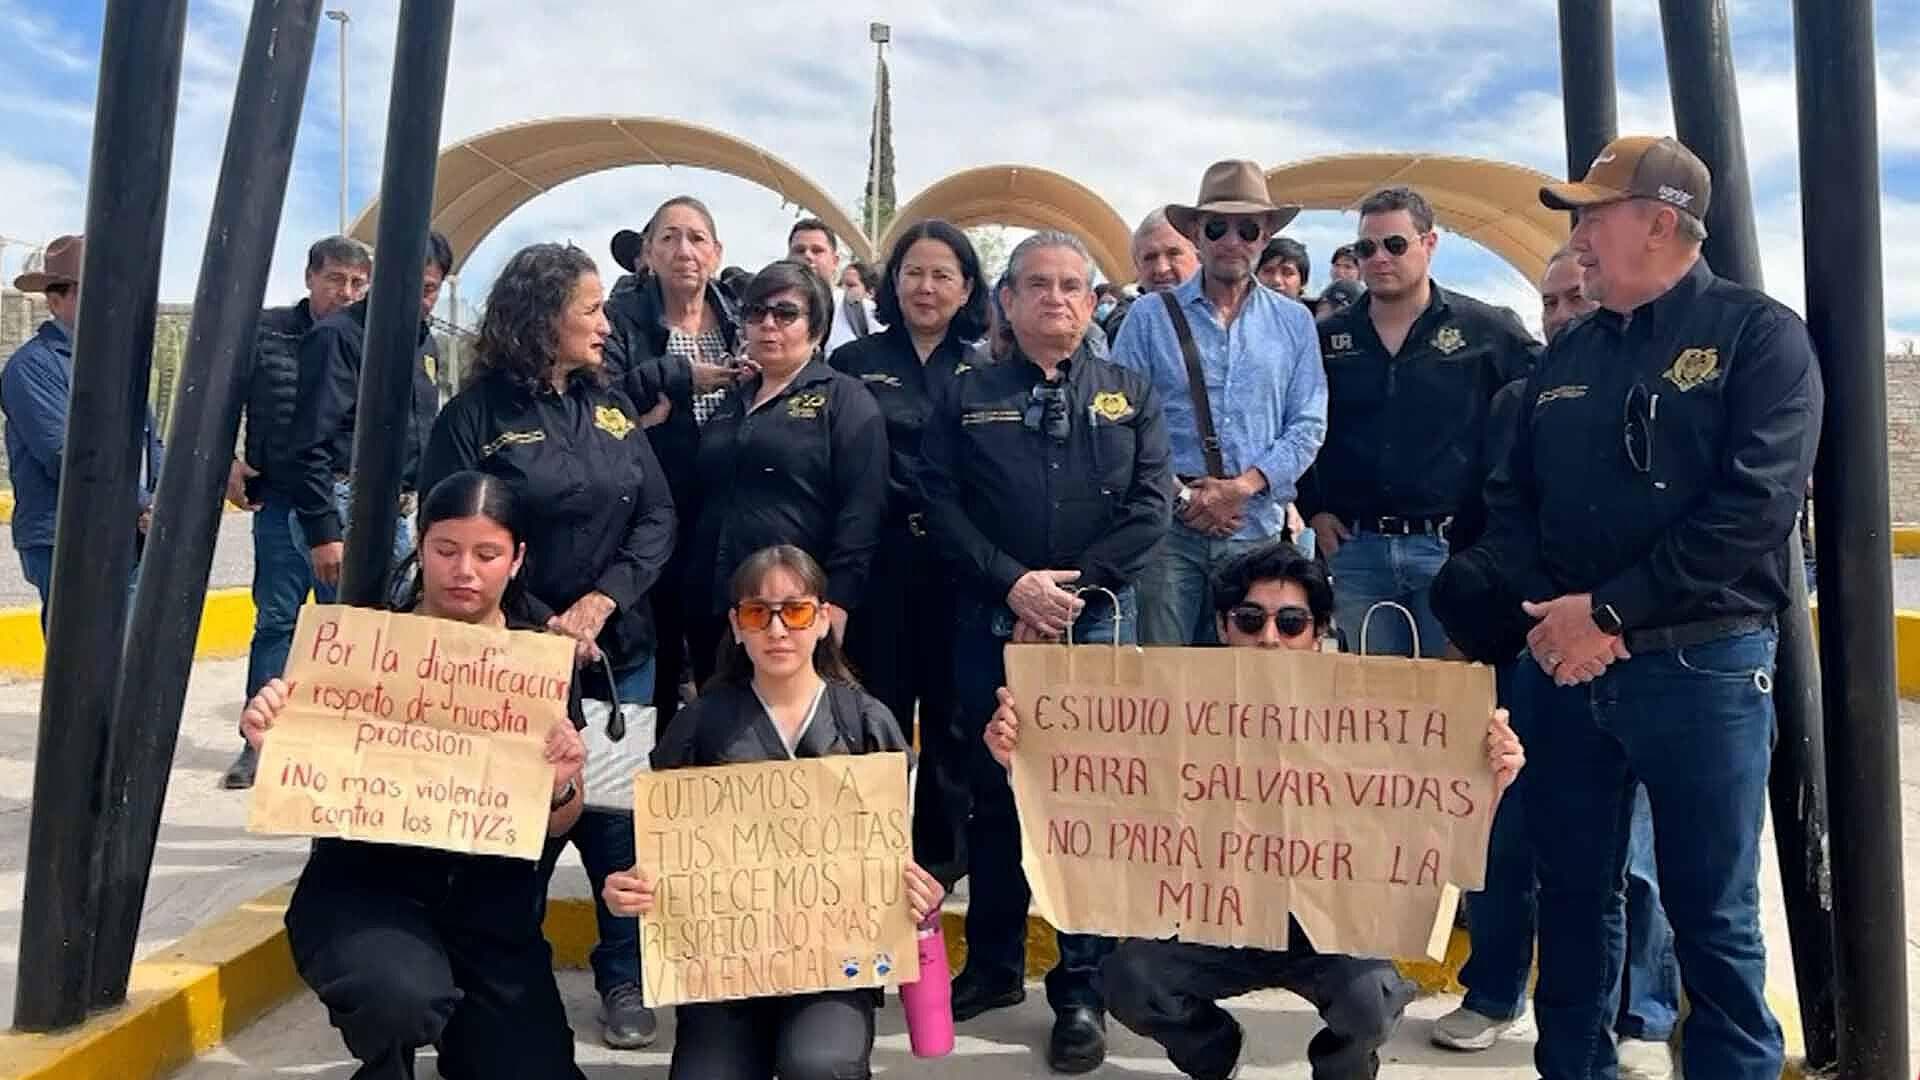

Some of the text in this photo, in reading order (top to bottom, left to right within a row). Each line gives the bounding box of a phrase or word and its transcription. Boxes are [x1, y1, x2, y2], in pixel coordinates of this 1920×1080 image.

[312, 621, 355, 667] Por
[371, 627, 399, 673] la
[312, 681, 394, 721] respeto
[405, 685, 433, 725] de
[453, 698, 529, 736] nuestra
[1034, 695, 1448, 749] ESTUDIO VETERINARIA
[415, 775, 510, 809] violencia
[648, 766, 865, 822] CUIDAMOS A
[1051, 754, 1475, 818] PARA SALVAR VIDAS
[311, 797, 385, 827] contra
[402, 805, 433, 835] los
[648, 824, 715, 877] TUS
[1046, 818, 1442, 888] NO PARA PERDER LA
[853, 854, 901, 908] TU
[1157, 879, 1243, 927] MIA
[820, 905, 882, 945] MAS
